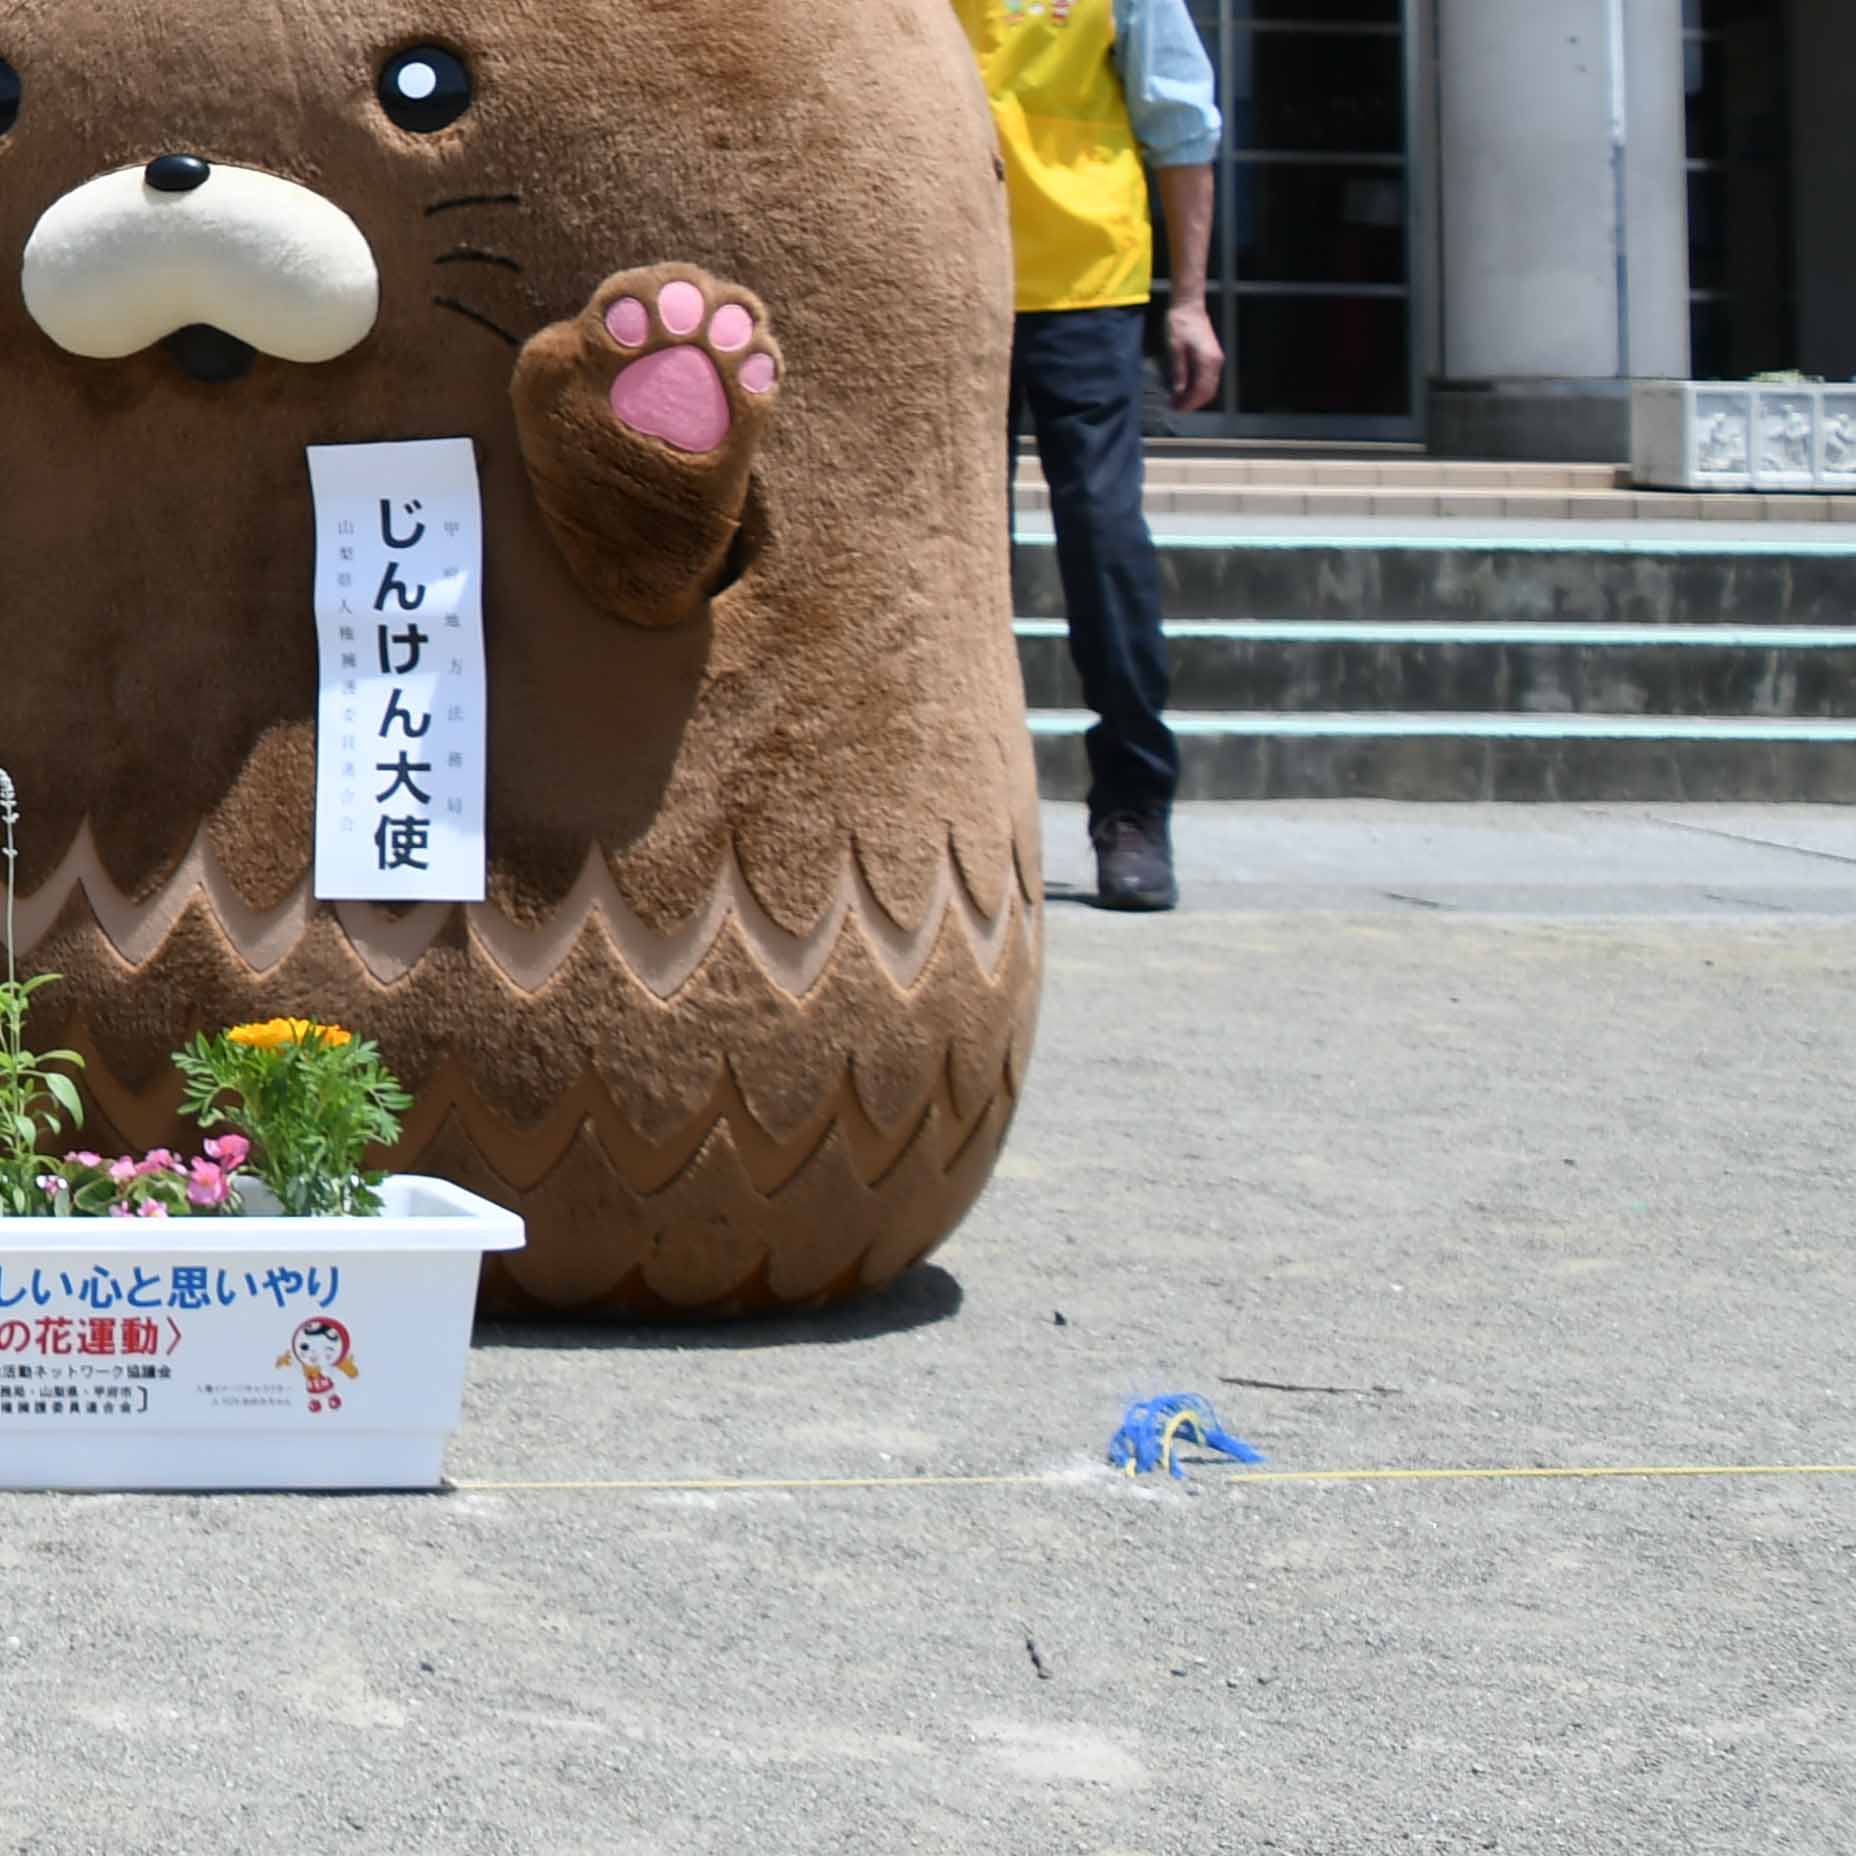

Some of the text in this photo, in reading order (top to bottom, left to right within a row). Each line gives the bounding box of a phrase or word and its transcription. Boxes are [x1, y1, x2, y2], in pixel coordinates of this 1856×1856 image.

[373, 497, 433, 871] じんけん大使
